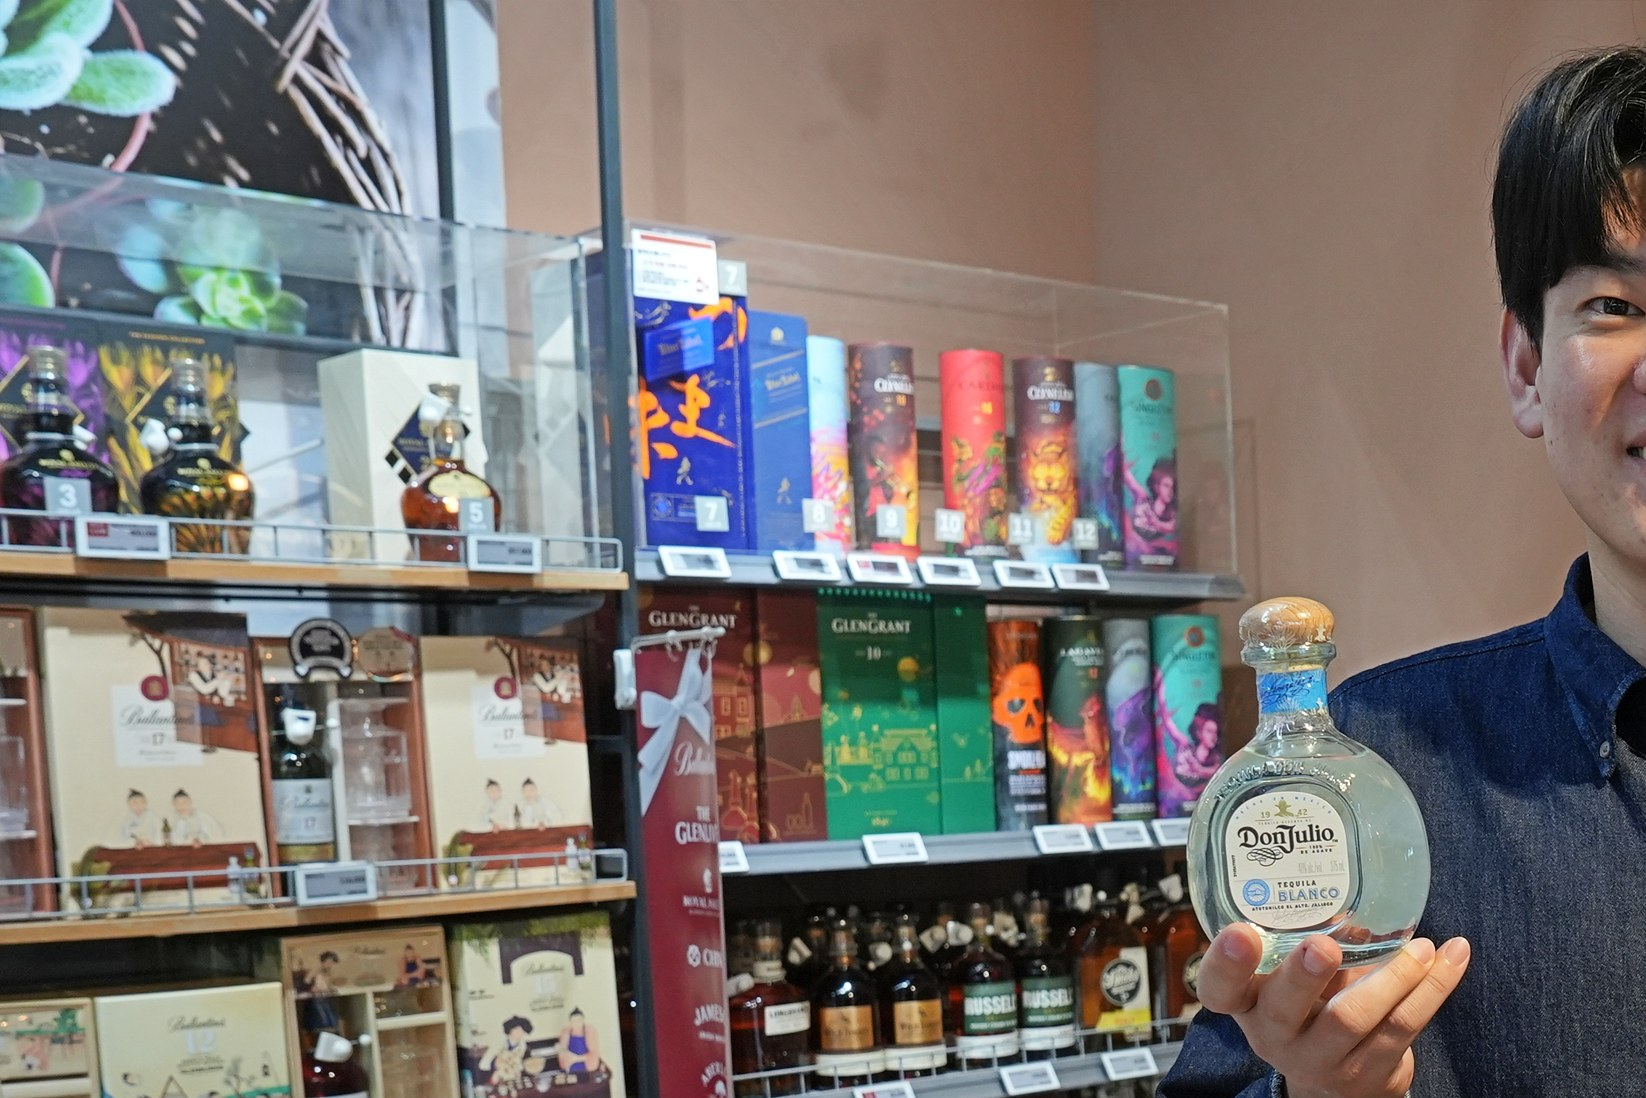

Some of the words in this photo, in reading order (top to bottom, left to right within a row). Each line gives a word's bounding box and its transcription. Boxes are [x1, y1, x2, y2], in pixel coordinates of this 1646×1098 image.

[58, 484, 77, 507] 3
[468, 502, 484, 523] 5
[705, 502, 717, 521] 7
[812, 504, 826, 523] 8
[884, 509, 898, 527] 9
[939, 513, 962, 533] 10
[1012, 516, 1031, 536] 11
[1075, 524, 1097, 543] 12
[866, 647, 882, 661] 10
[1277, 880, 1317, 888] TEQUILA
[1278, 886, 1341, 902] BLANCO
